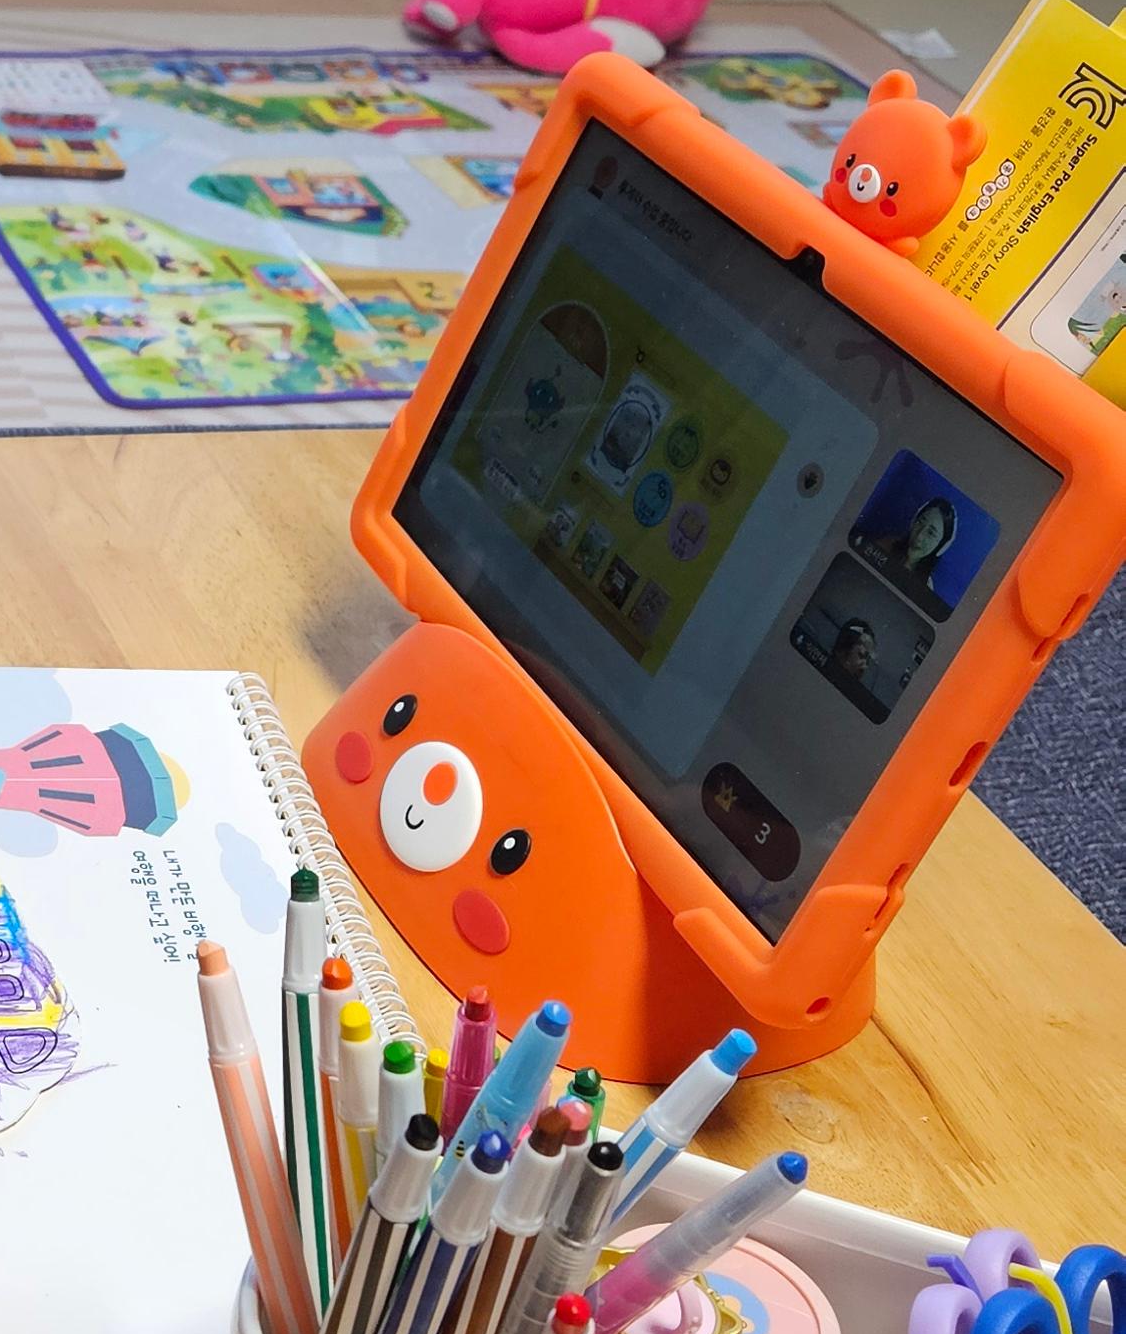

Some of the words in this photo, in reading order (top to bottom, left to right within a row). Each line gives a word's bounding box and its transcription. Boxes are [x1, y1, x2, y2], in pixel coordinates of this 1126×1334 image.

[1031, 107, 1056, 137] 환경을
[1013, 140, 1032, 160] 위해
[1068, 134, 1097, 171] Super
[1042, 151, 1066, 180] 주식회사
[1050, 171, 1071, 192] Pot
[1013, 181, 1044, 218] 웅진씽크빅
[1017, 193, 1054, 234] English
[978, 239, 997, 260] 경기도
[994, 236, 1019, 262] Story
[960, 262, 979, 284] 파주시
[970, 264, 996, 294] Level
[963, 294, 973, 302] 1
[754, 822, 771, 845] 3
[131, 850, 157, 886] 여행을
[163, 850, 183, 878] 내가
[146, 890, 169, 927] 떠나고
[170, 882, 196, 906] 만든
[153, 932, 181, 962] 싶어!
[182, 910, 207, 960] 비행
